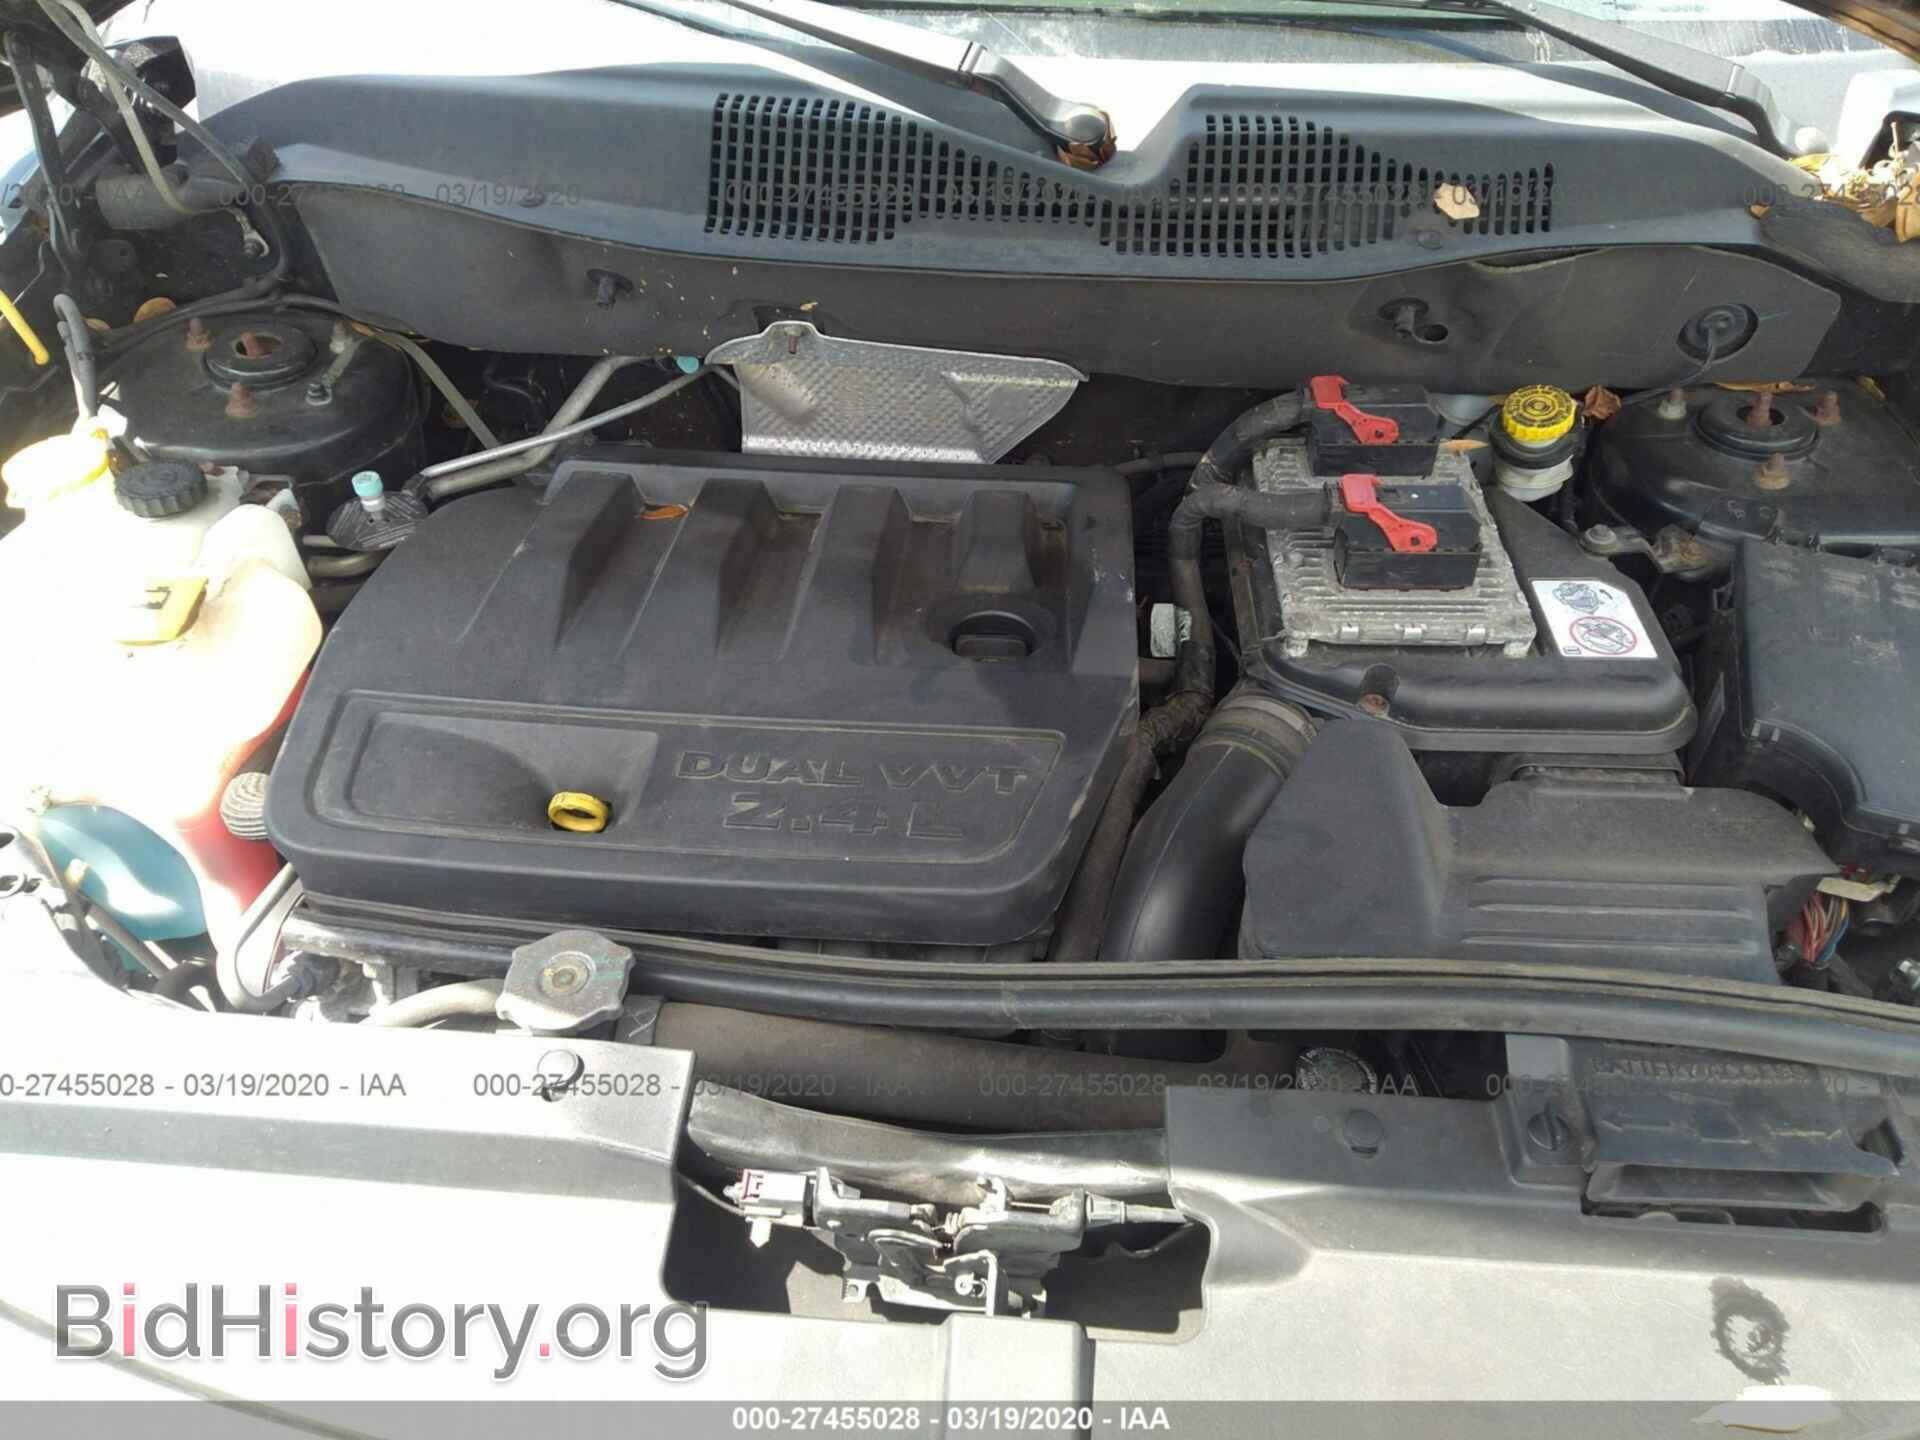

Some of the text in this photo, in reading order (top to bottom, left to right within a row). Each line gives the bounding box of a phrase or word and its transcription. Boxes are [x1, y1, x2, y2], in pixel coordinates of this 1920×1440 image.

[676, 751, 1028, 795] DUAL VVT
[723, 791, 966, 841] 2.4L
